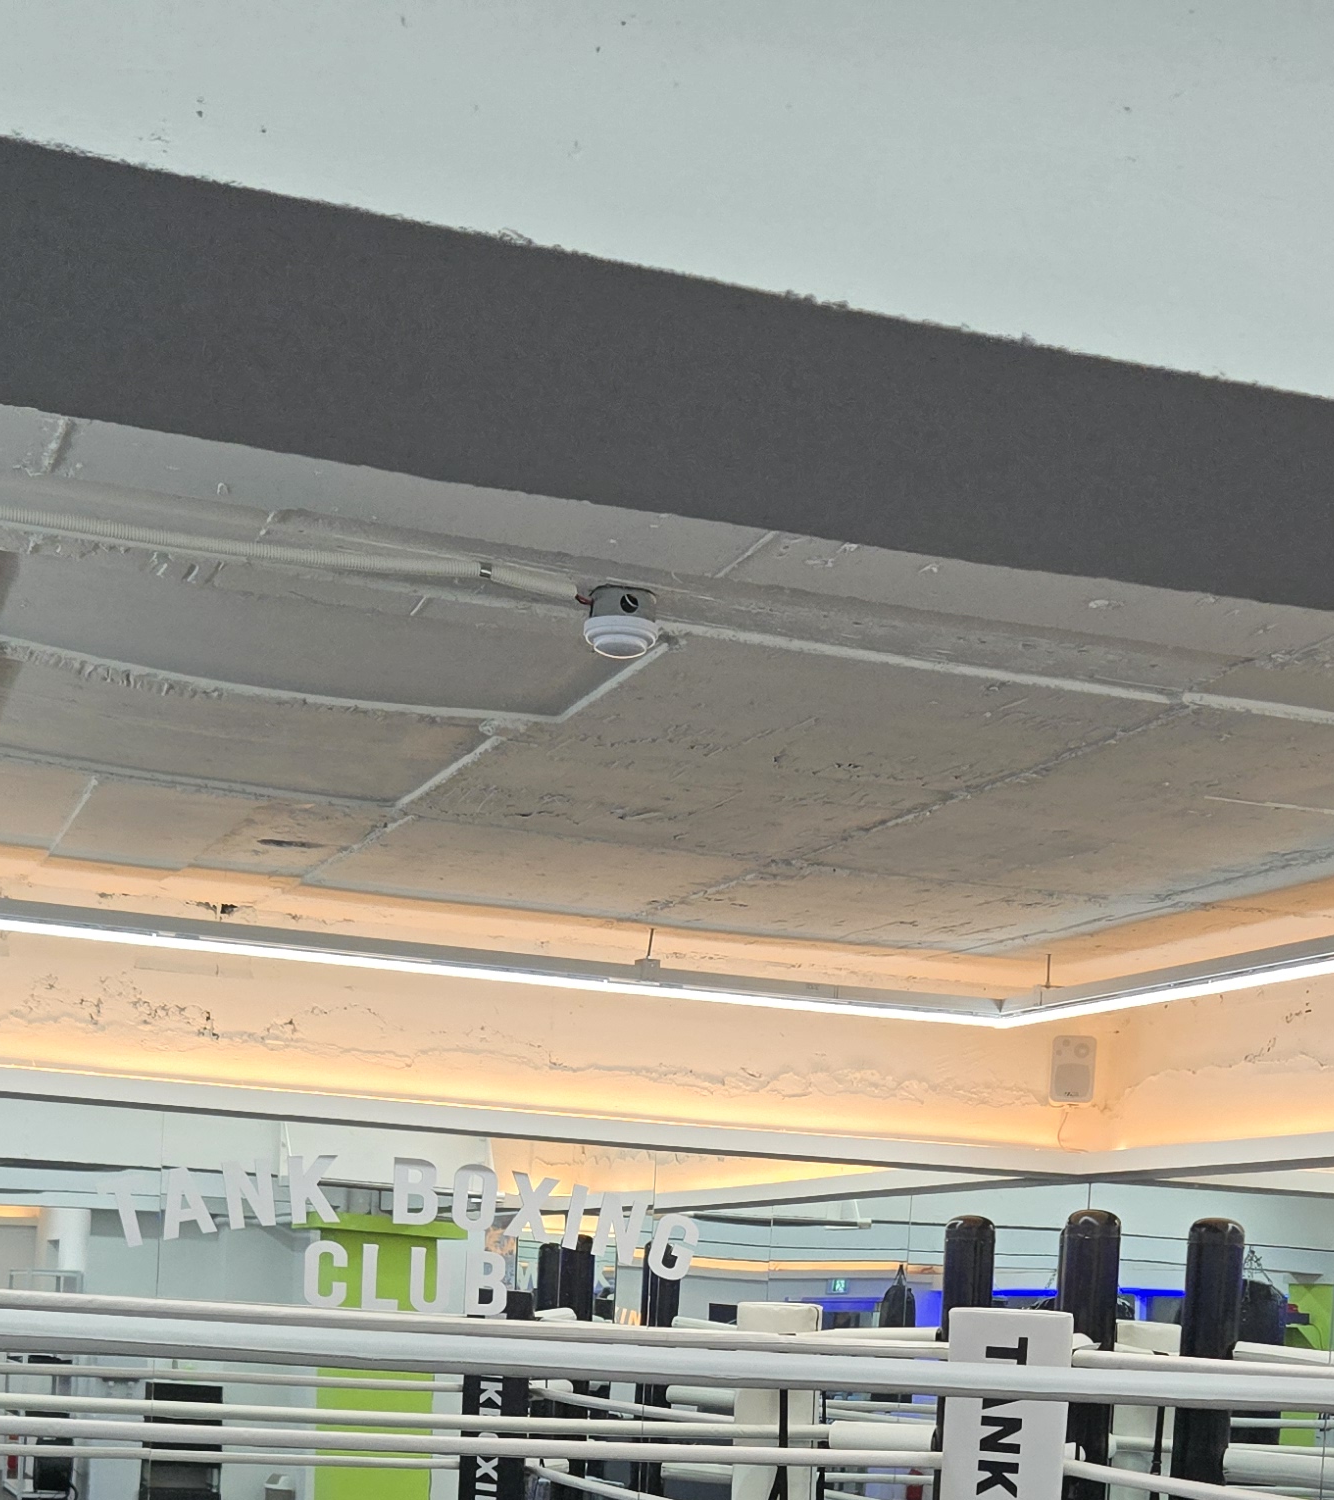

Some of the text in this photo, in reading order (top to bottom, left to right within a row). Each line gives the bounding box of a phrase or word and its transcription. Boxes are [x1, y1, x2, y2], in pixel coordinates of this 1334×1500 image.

[96, 1155, 699, 1280] TANK BOXING
[304, 1240, 508, 1316] CLUB
